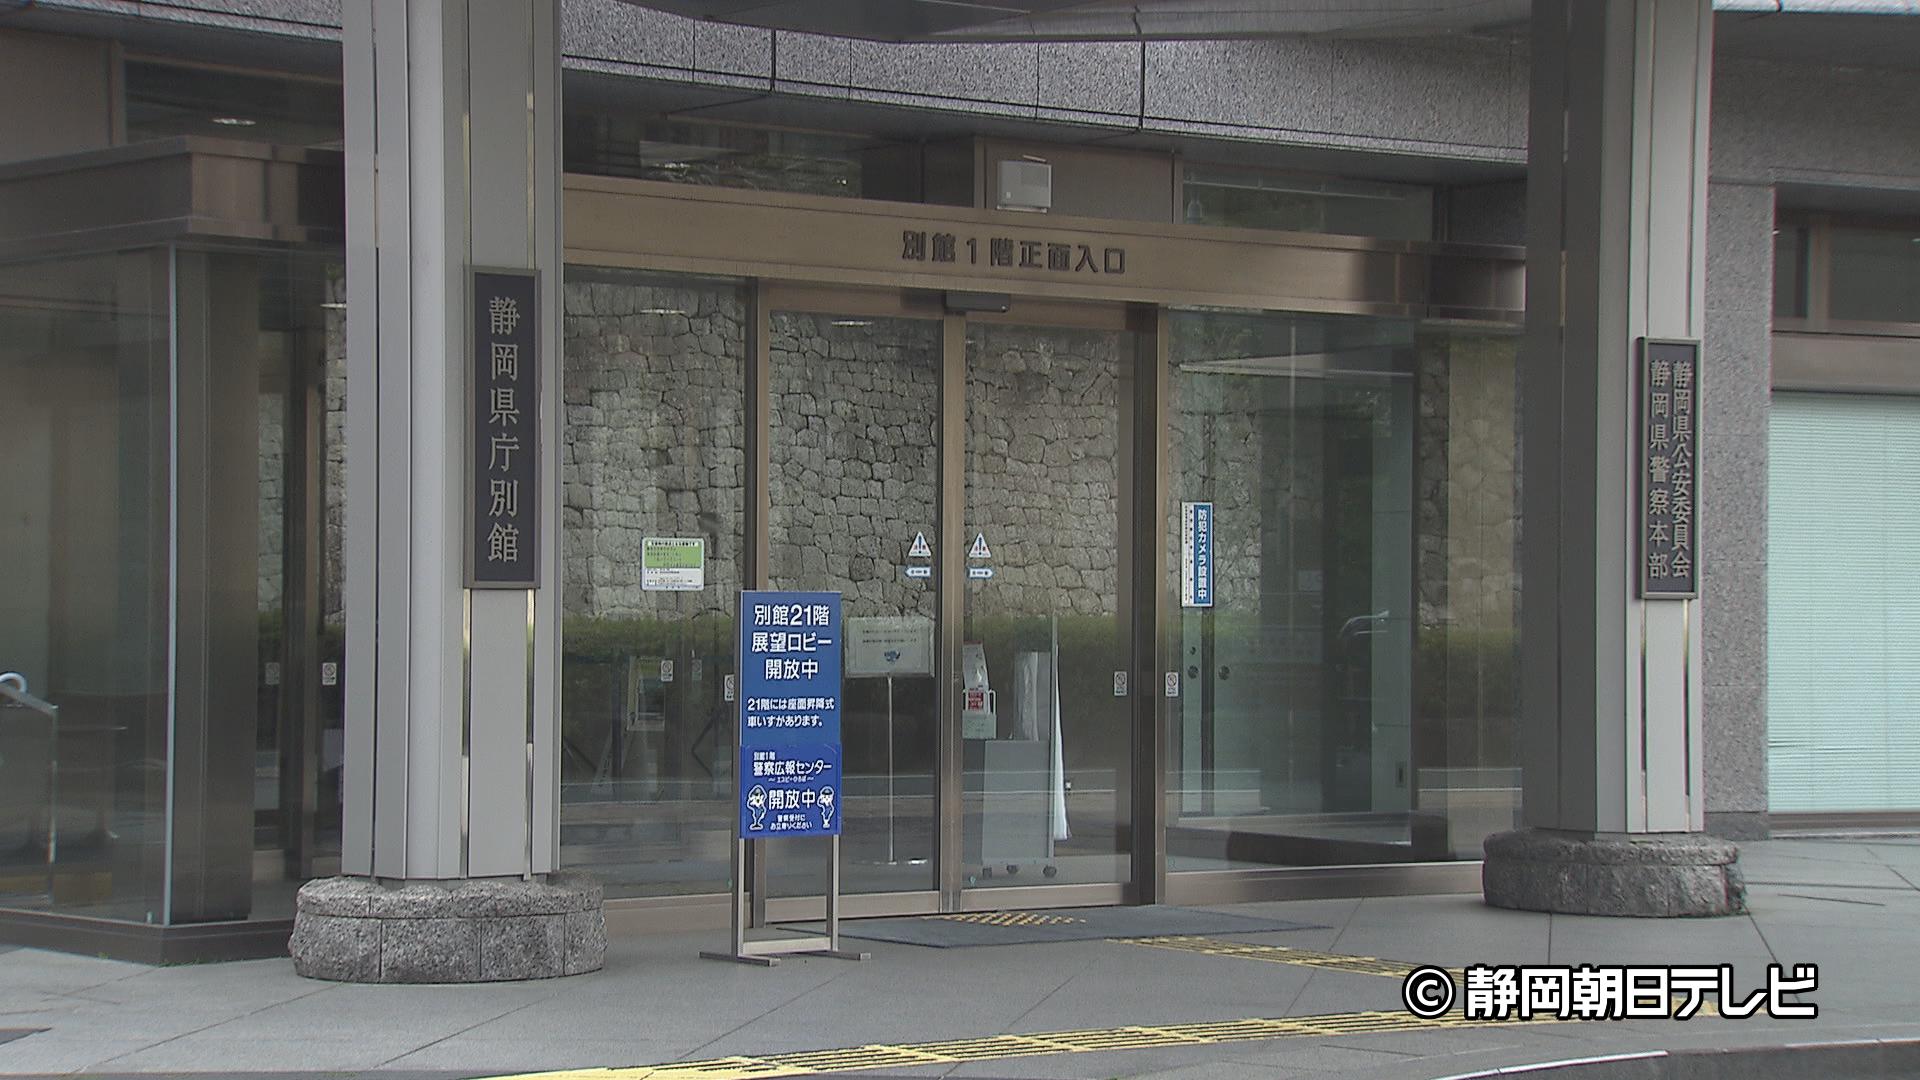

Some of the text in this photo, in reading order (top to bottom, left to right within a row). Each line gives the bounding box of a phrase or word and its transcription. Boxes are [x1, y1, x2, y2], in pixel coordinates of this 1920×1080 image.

[901, 229, 1126, 274] 別館1階正面入口
[487, 295, 521, 563] 静岡県庁別館
[1648, 359, 1671, 580] 静岡県警察本部
[1671, 360, 1693, 578] 静岡県公安委員会
[753, 604, 830, 626] 別館21階
[751, 631, 832, 653] 展望ロビー
[765, 658, 819, 680] 開放中
[747, 697, 835, 711] 21階には座面昇降式
[753, 759, 832, 776] 警察広報センター
[768, 788, 816, 810] 開放中
